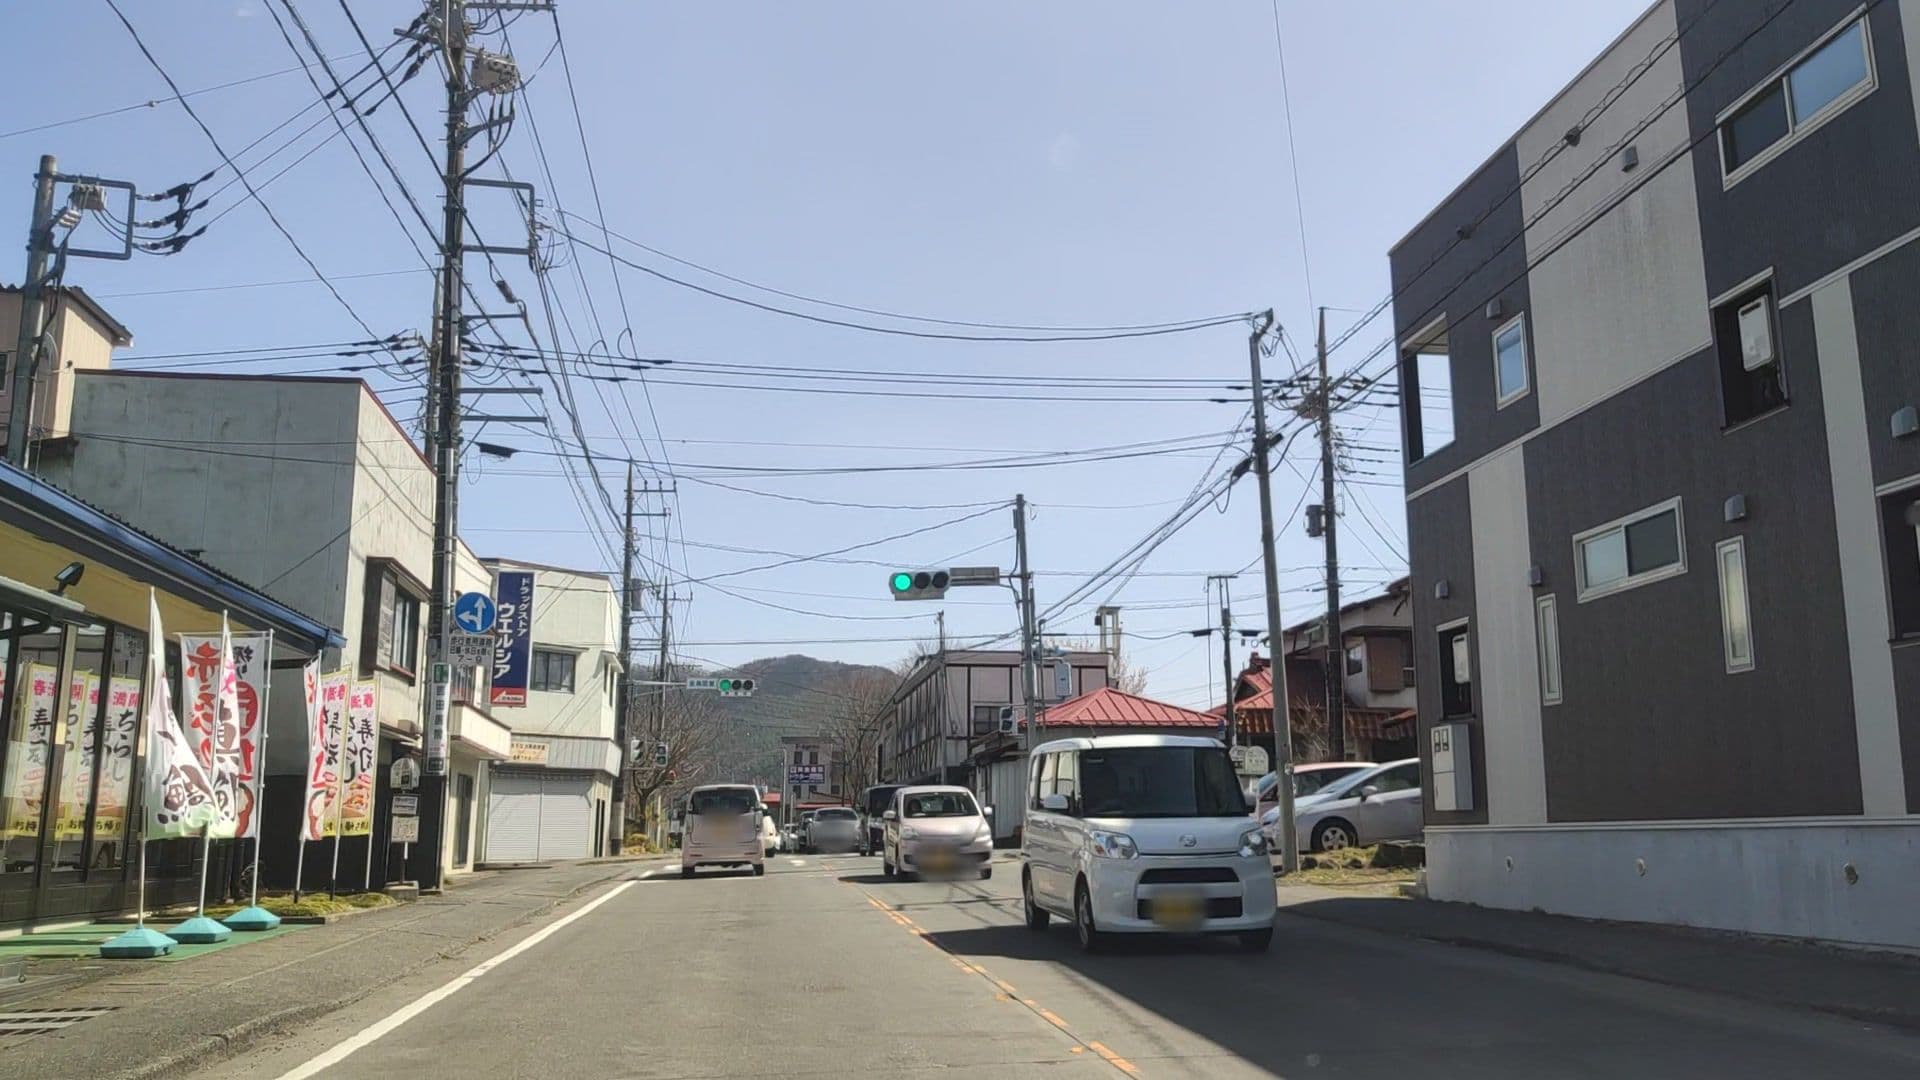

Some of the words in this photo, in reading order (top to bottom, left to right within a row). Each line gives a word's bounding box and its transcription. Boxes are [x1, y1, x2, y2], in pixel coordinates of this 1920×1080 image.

[494, 602, 515, 680] ウエルシア
[517, 577, 531, 637] ドラッグストア
